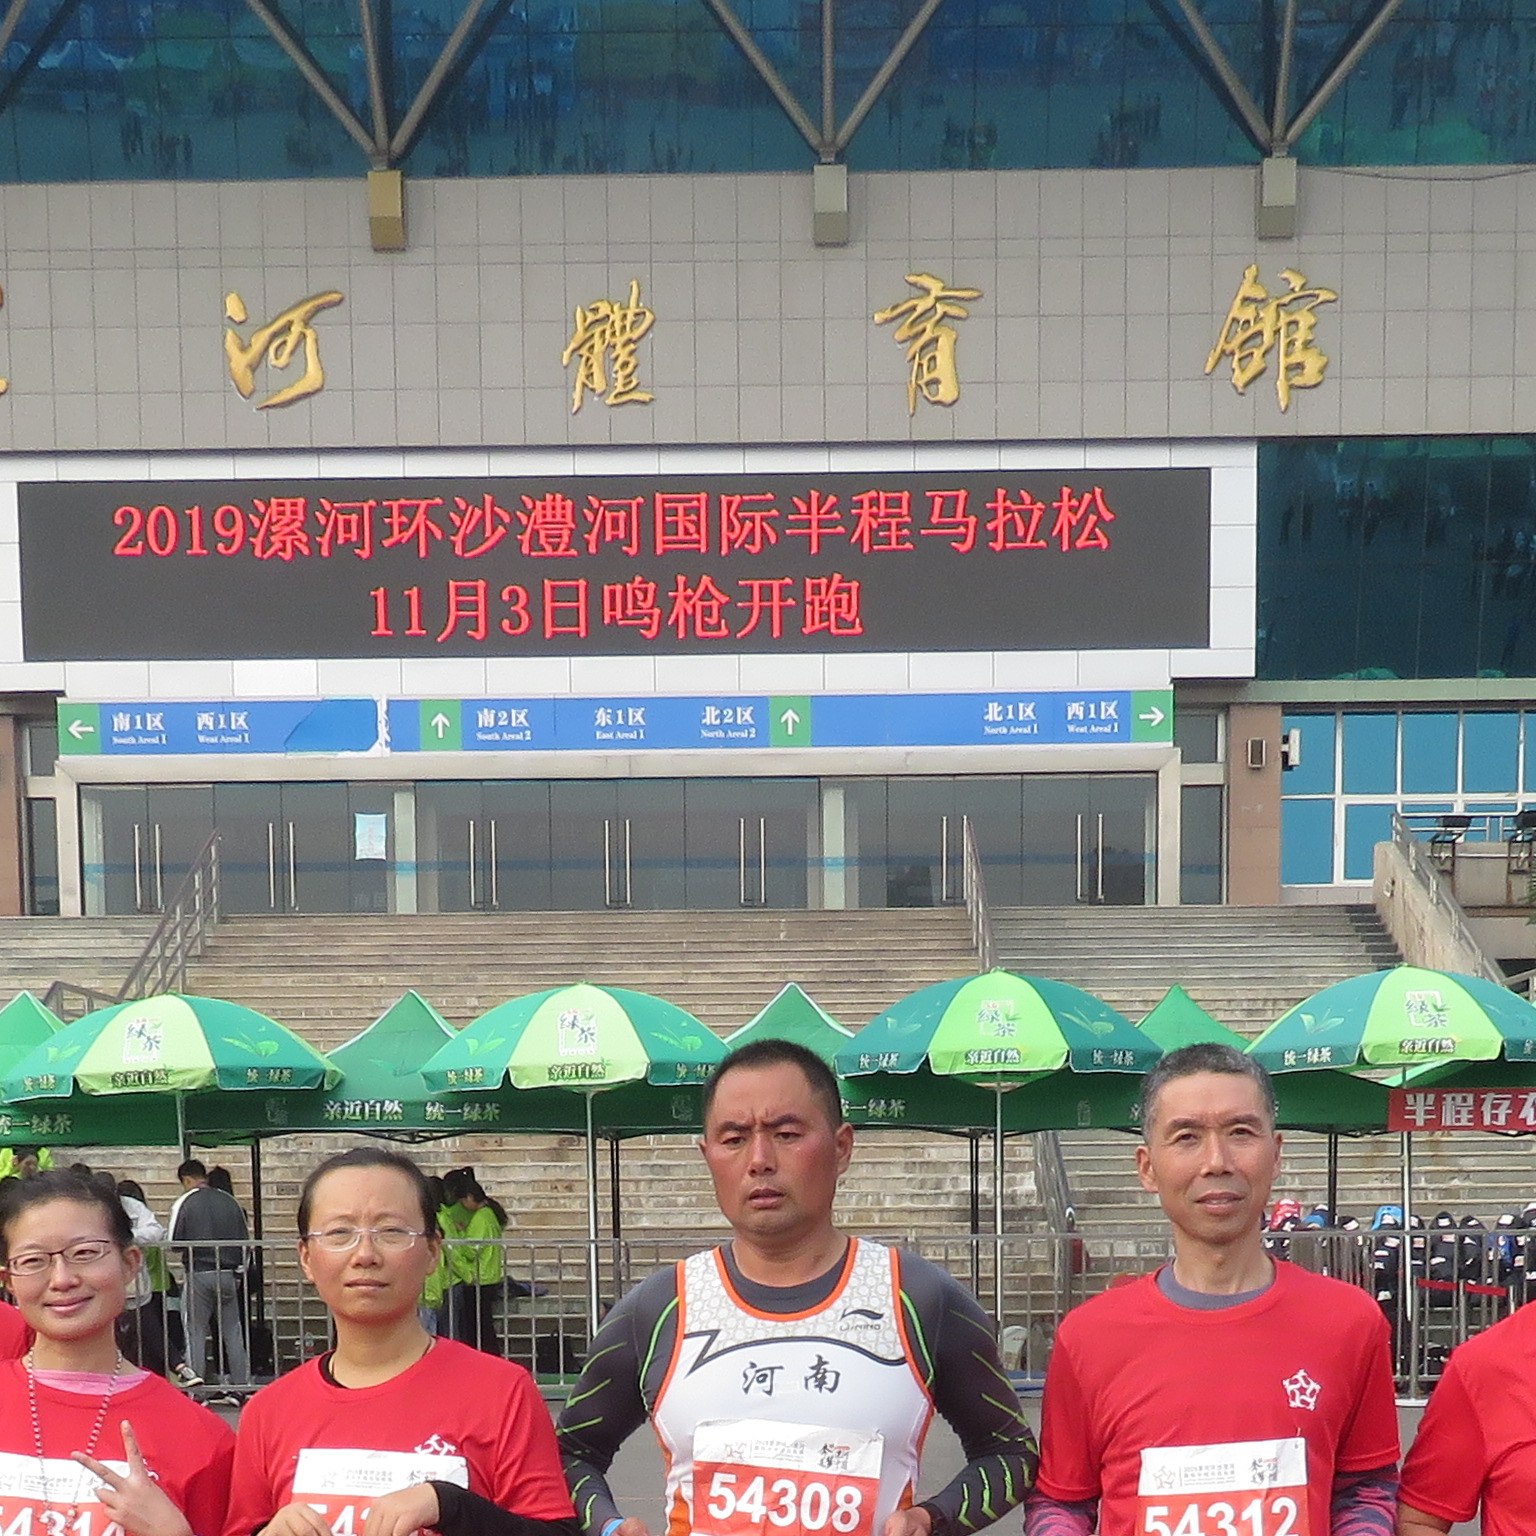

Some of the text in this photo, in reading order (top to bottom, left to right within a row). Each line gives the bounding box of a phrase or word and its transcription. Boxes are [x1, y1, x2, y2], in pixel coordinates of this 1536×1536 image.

[113, 484, 1116, 563] 2019漯河环沙澧河国际半程马拉松
[370, 574, 864, 644] 11月3日鸣枪开跑
[477, 708, 530, 729] 南2区
[594, 707, 646, 727] 东1区
[701, 705, 755, 727] 北2区
[983, 702, 1036, 721] 北1区
[1066, 700, 1119, 720] 西1区
[112, 712, 164, 732] 南1区
[196, 711, 250, 732] 西1区
[323, 1099, 501, 1122] 亲近自然 统一绿茶
[742, 1354, 841, 1397] 河南
[707, 1472, 863, 1533] 54308
